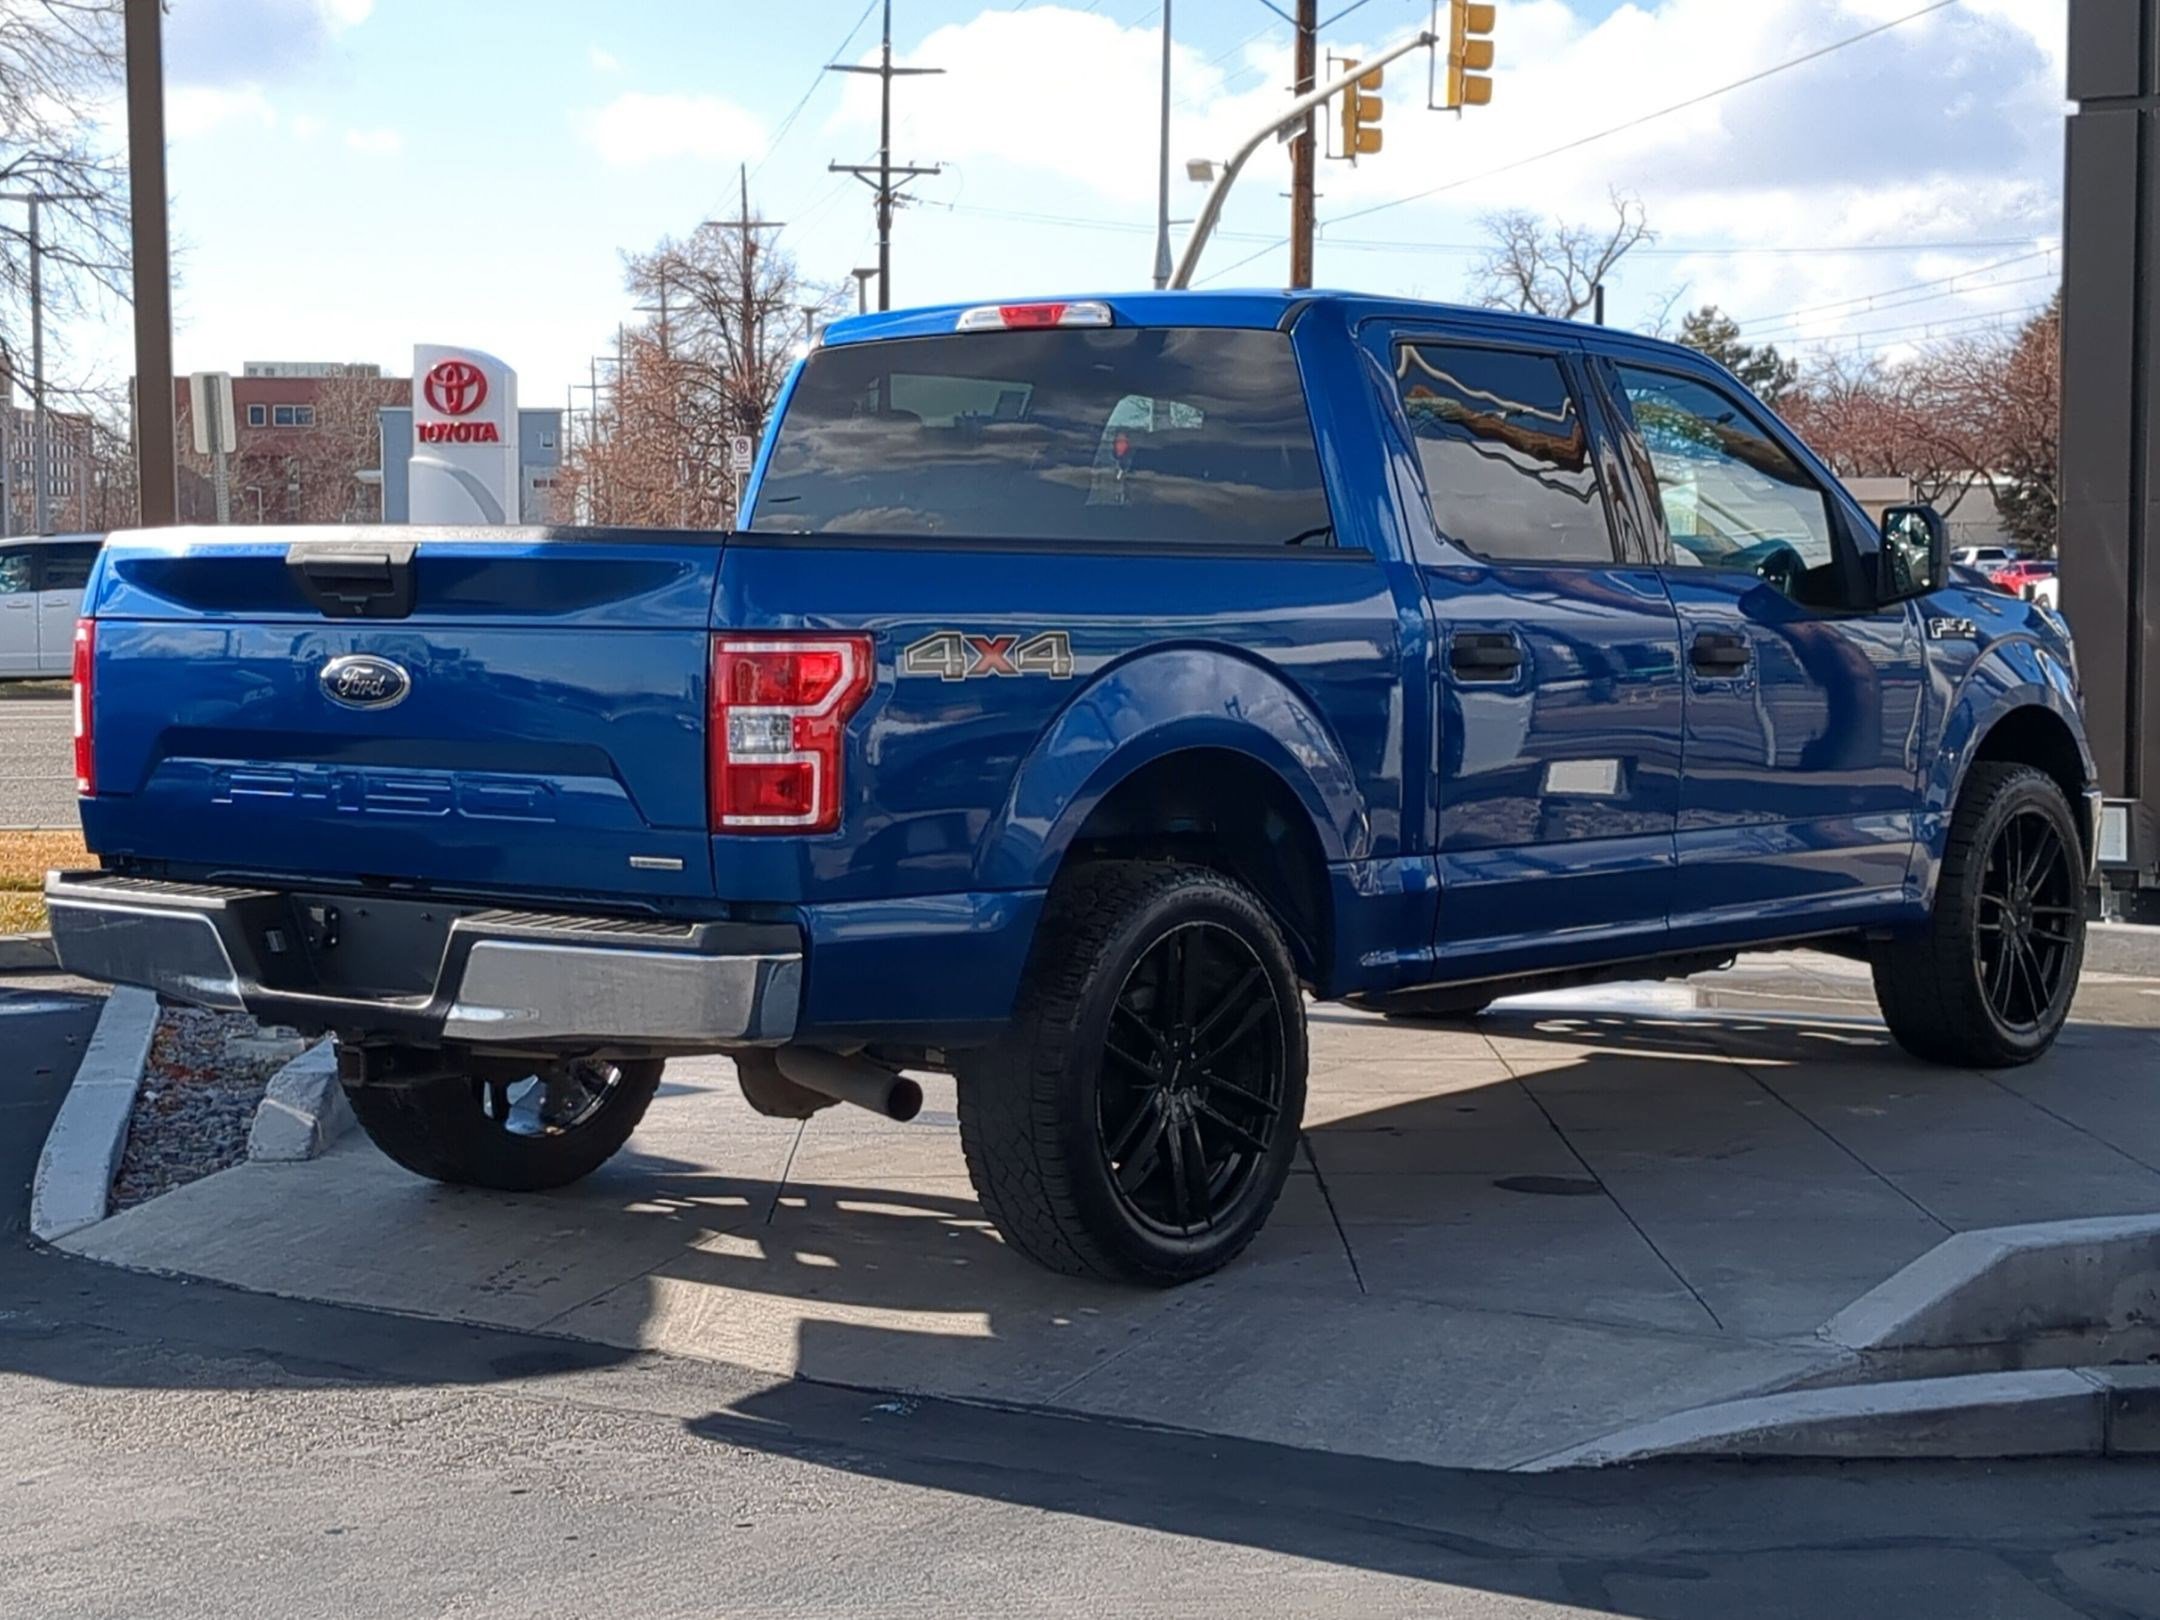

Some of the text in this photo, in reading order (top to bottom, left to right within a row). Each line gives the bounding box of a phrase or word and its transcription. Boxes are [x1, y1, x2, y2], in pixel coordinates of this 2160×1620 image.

[416, 422, 499, 443] TOYOTA
[337, 665, 386, 696] Ford
[210, 766, 556, 823] F-150
